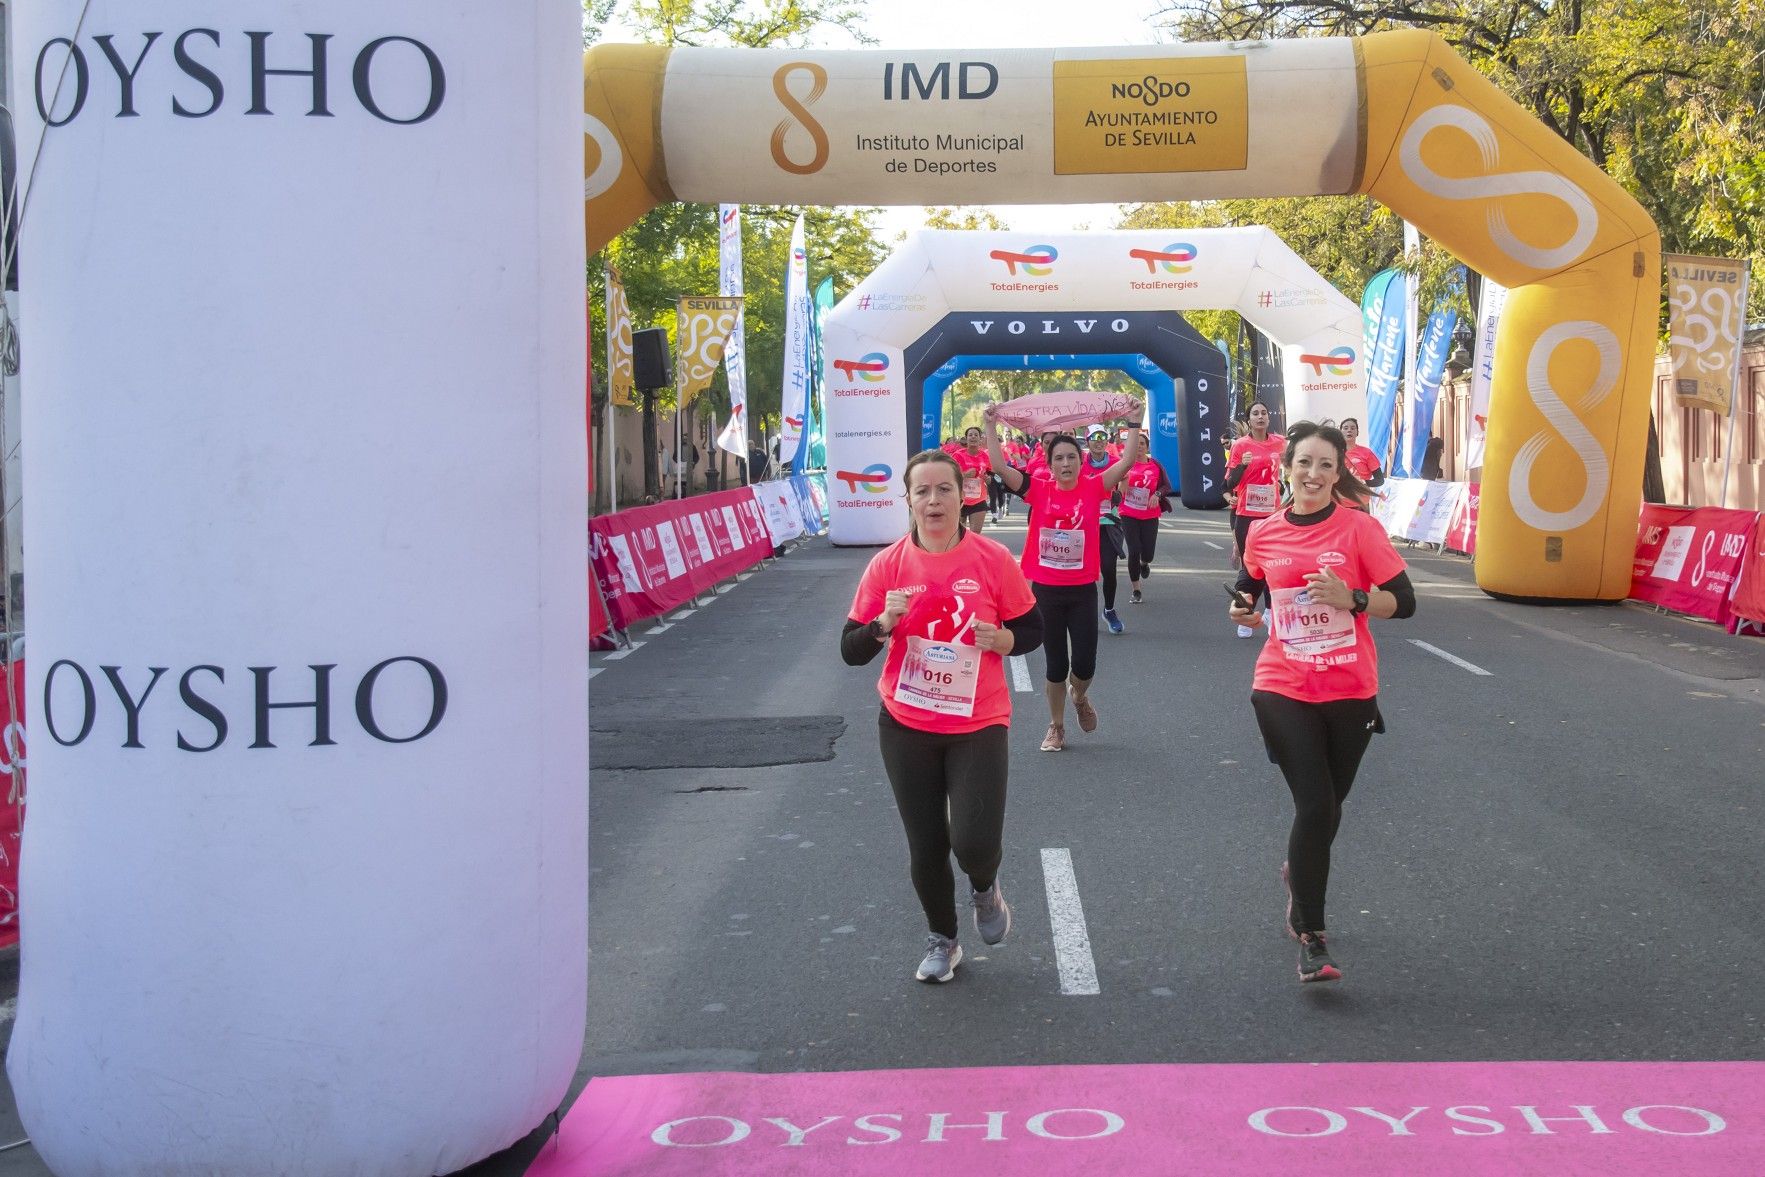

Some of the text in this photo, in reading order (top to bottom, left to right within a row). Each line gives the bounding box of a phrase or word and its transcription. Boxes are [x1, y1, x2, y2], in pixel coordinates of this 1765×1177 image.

[35, 29, 446, 127] OYSHO
[884, 62, 999, 100] IMD
[857, 134, 1024, 153] Instituto Municipal
[1132, 130, 1196, 146] SEVILLA
[885, 158, 997, 175] de Deportes
[990, 282, 1059, 293] TotalEnergies
[1130, 280, 1198, 290] TotalEnergies
[687, 300, 739, 310] SEVILLA
[971, 318, 1129, 334] VOLVO
[834, 388, 891, 398] TotalEnergies
[1301, 382, 1357, 392] TotalEnergies
[1198, 378, 1213, 492] VOLVO
[837, 500, 893, 509] TotalEnergies
[1053, 545, 1070, 553] 016
[1301, 612, 1329, 626] 016
[924, 670, 953, 684] 016
[45, 656, 448, 752] OYSHO
[651, 1109, 1125, 1147] OYSHO
[1248, 1105, 1727, 1137] OYSHO
